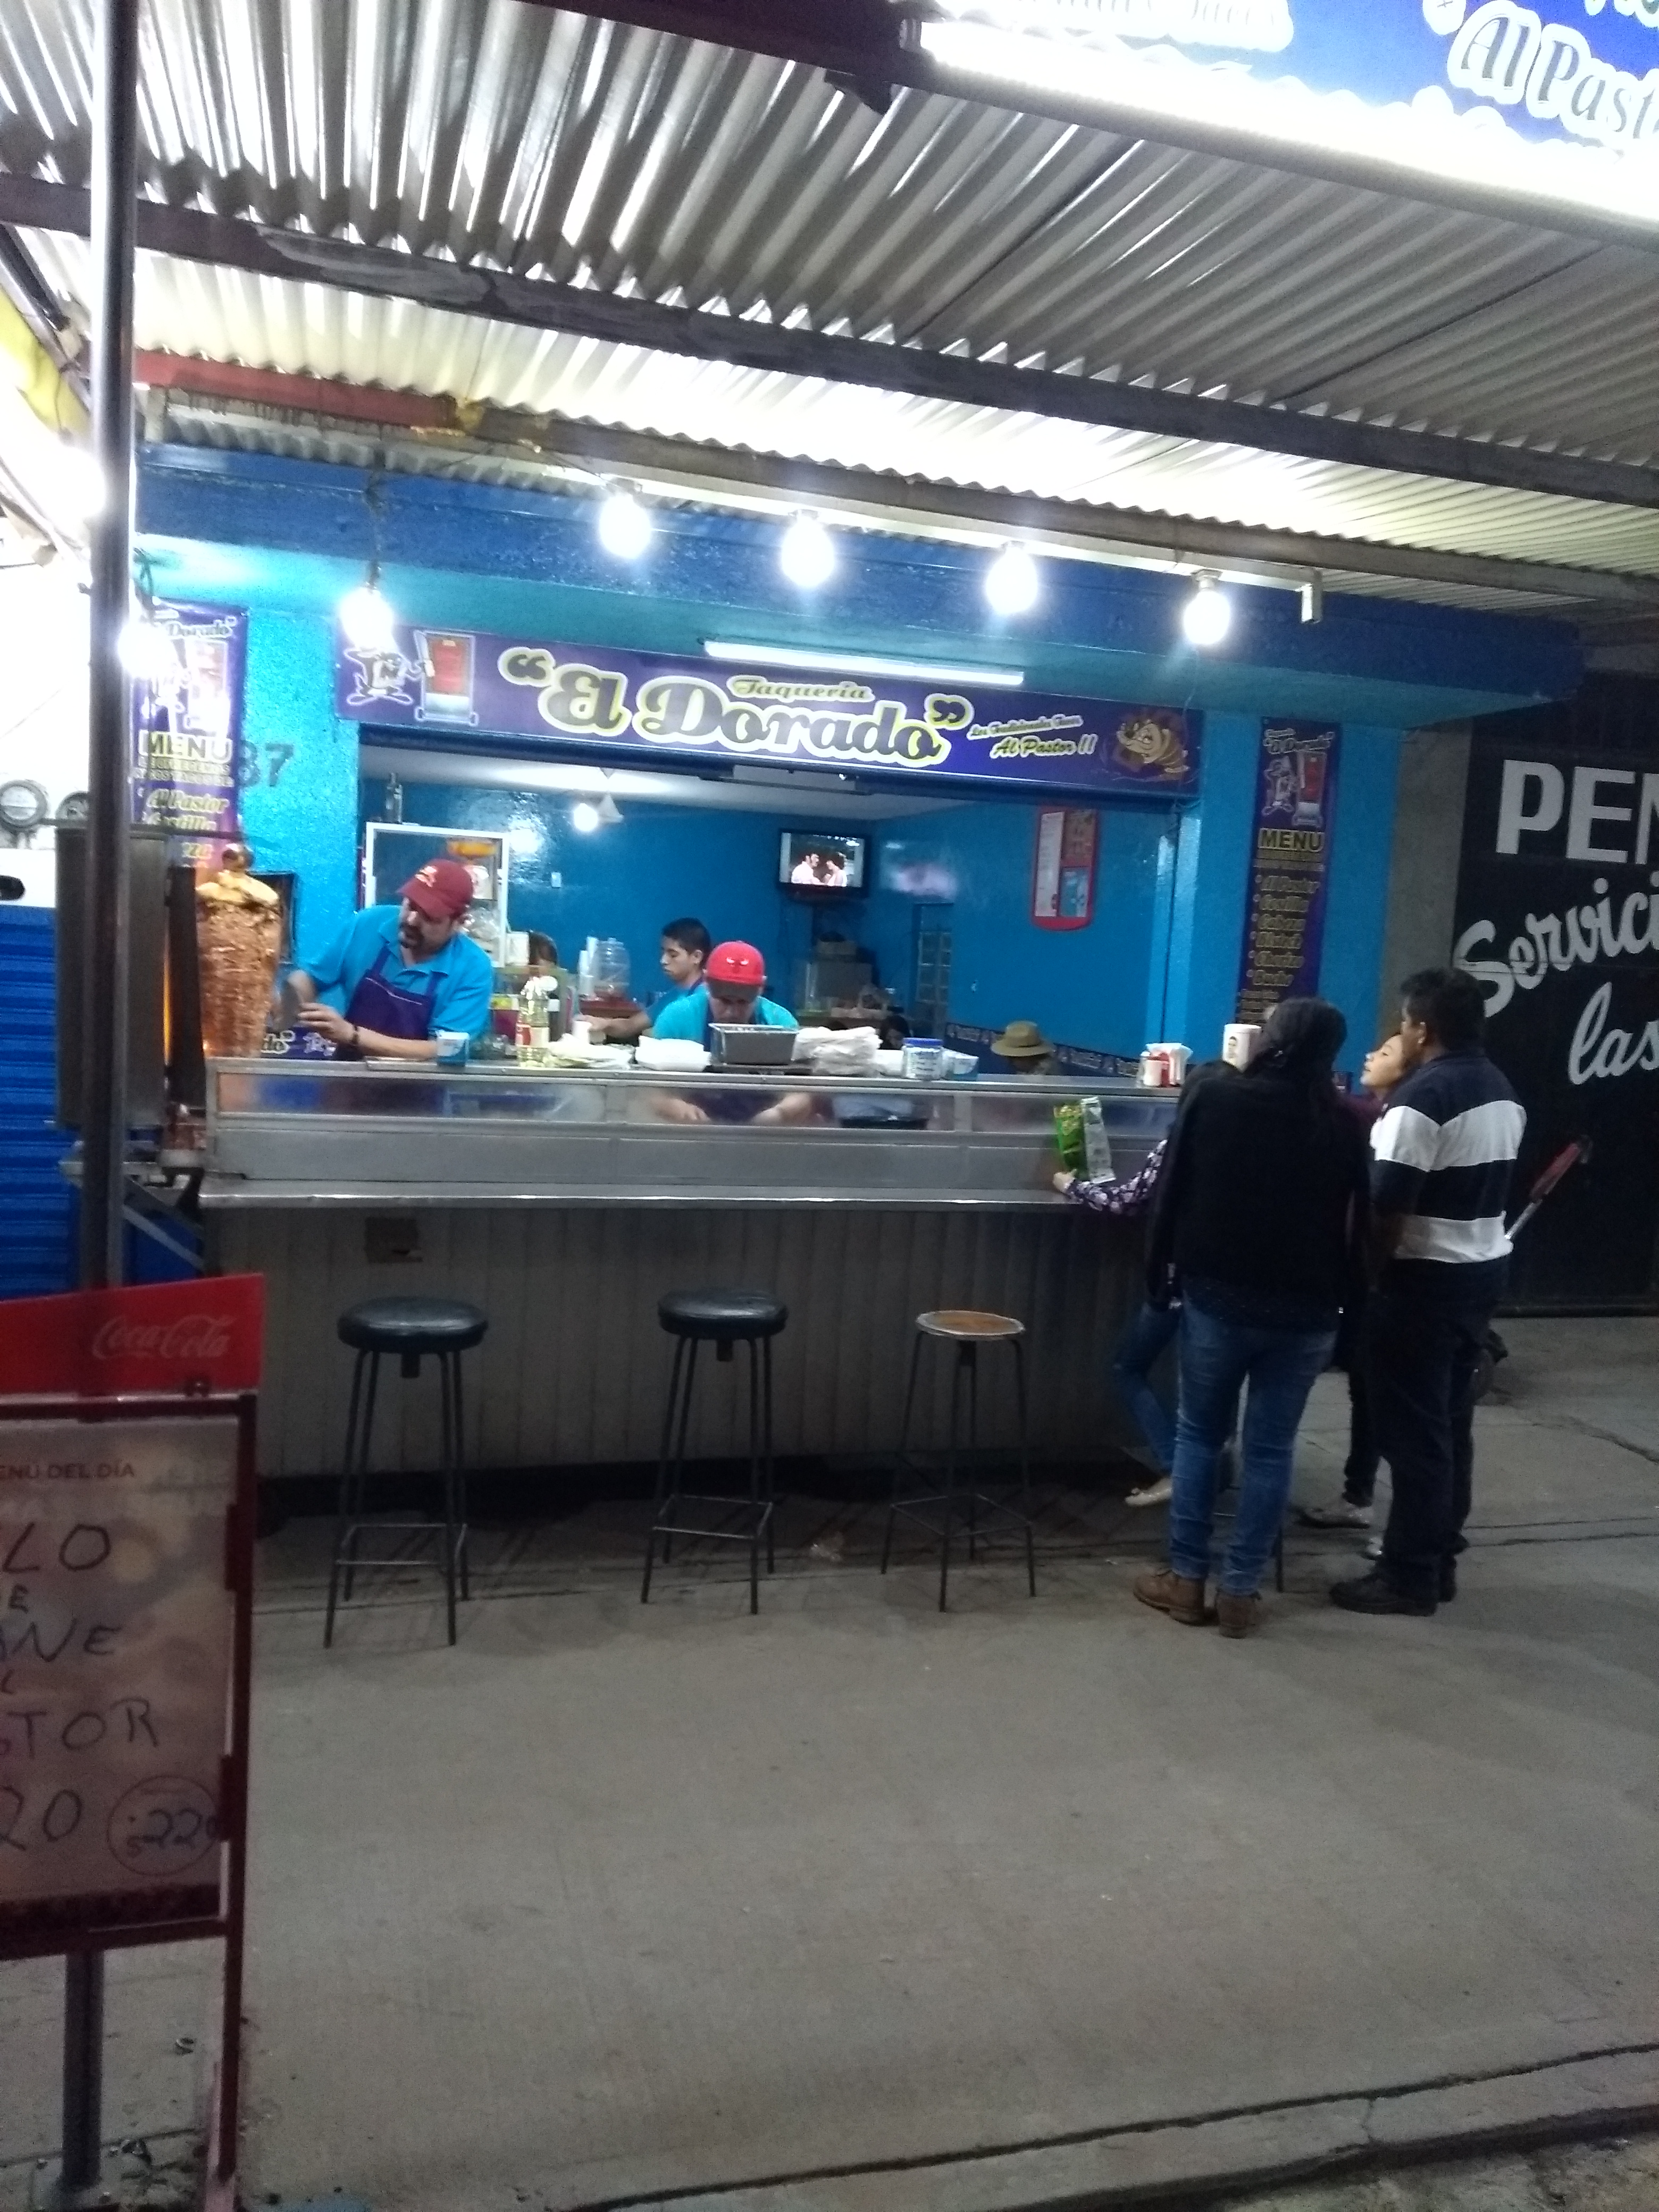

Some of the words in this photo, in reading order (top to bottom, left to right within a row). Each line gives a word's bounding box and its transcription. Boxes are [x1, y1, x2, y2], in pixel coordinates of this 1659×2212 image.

[1461, 15, 1530, 88] Al
[1538, 38, 1659, 139] Past
[1261, 830, 1322, 851] MENU
[47, 1463, 90, 1479] DEL
